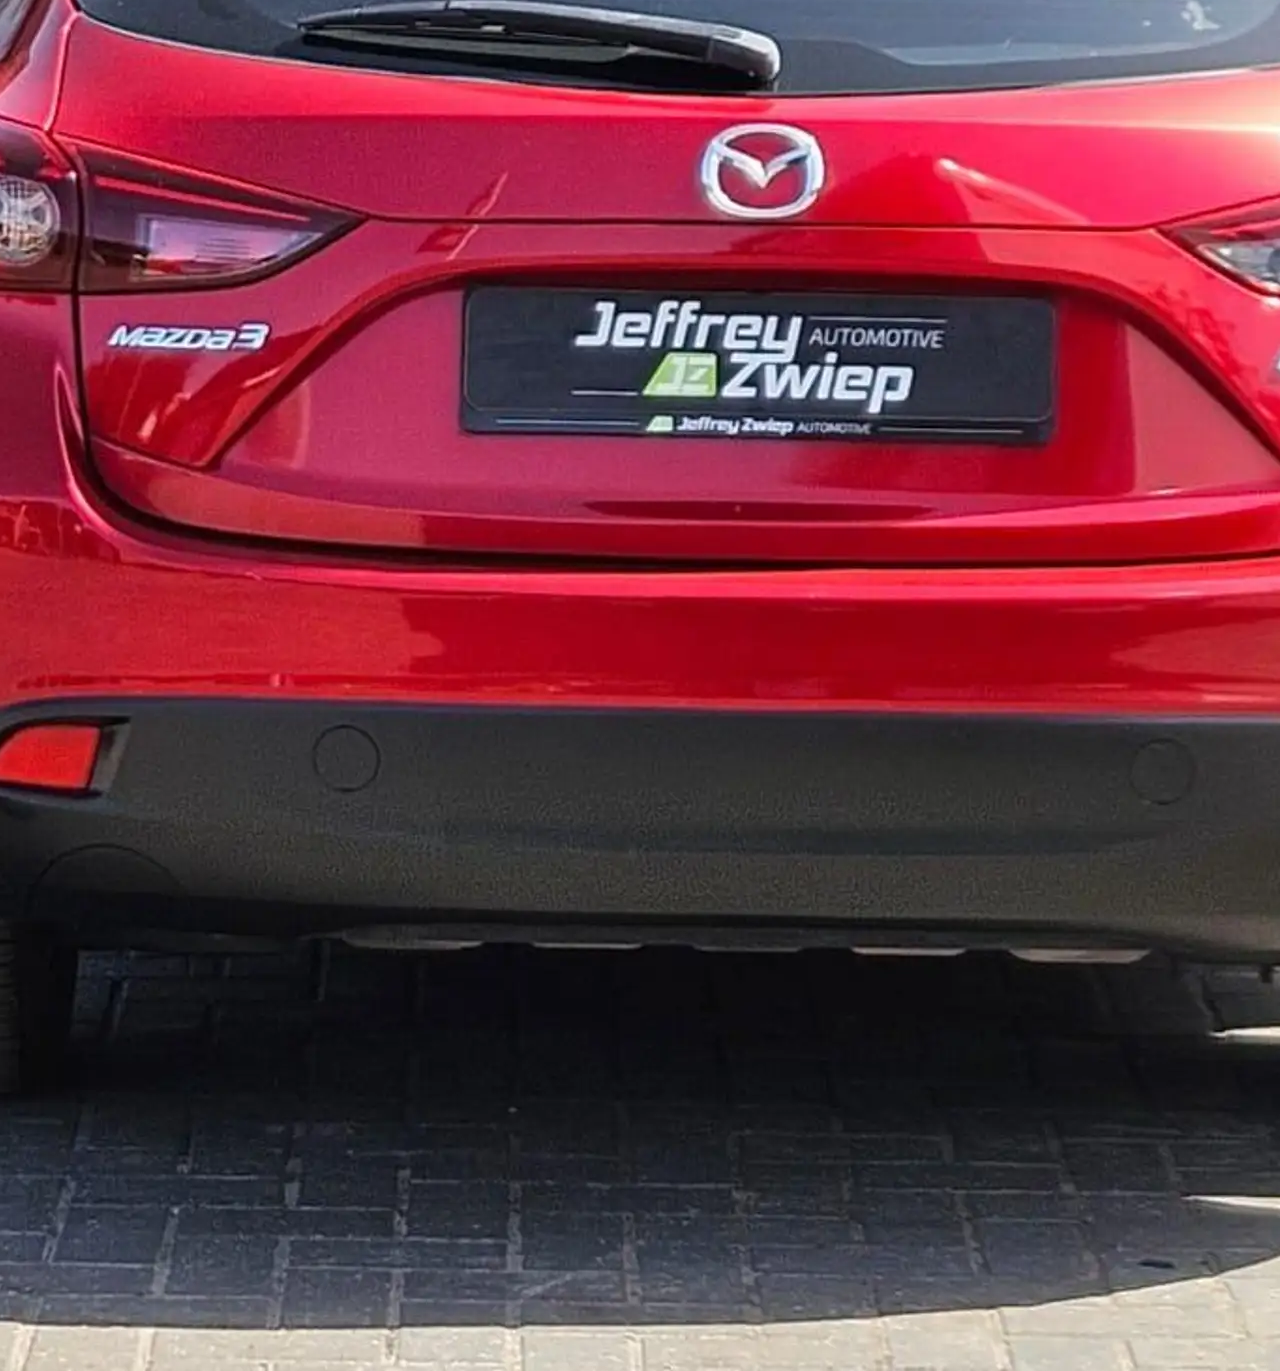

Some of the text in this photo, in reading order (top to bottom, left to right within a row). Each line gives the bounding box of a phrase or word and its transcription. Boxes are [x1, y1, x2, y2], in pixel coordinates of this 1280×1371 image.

[574, 300, 946, 364] Jeffrey AUTOMOTIVE
[721, 351, 914, 414] Zwiep
[677, 416, 872, 436] Jeffrey Zwiep AUTOMOTIVE
